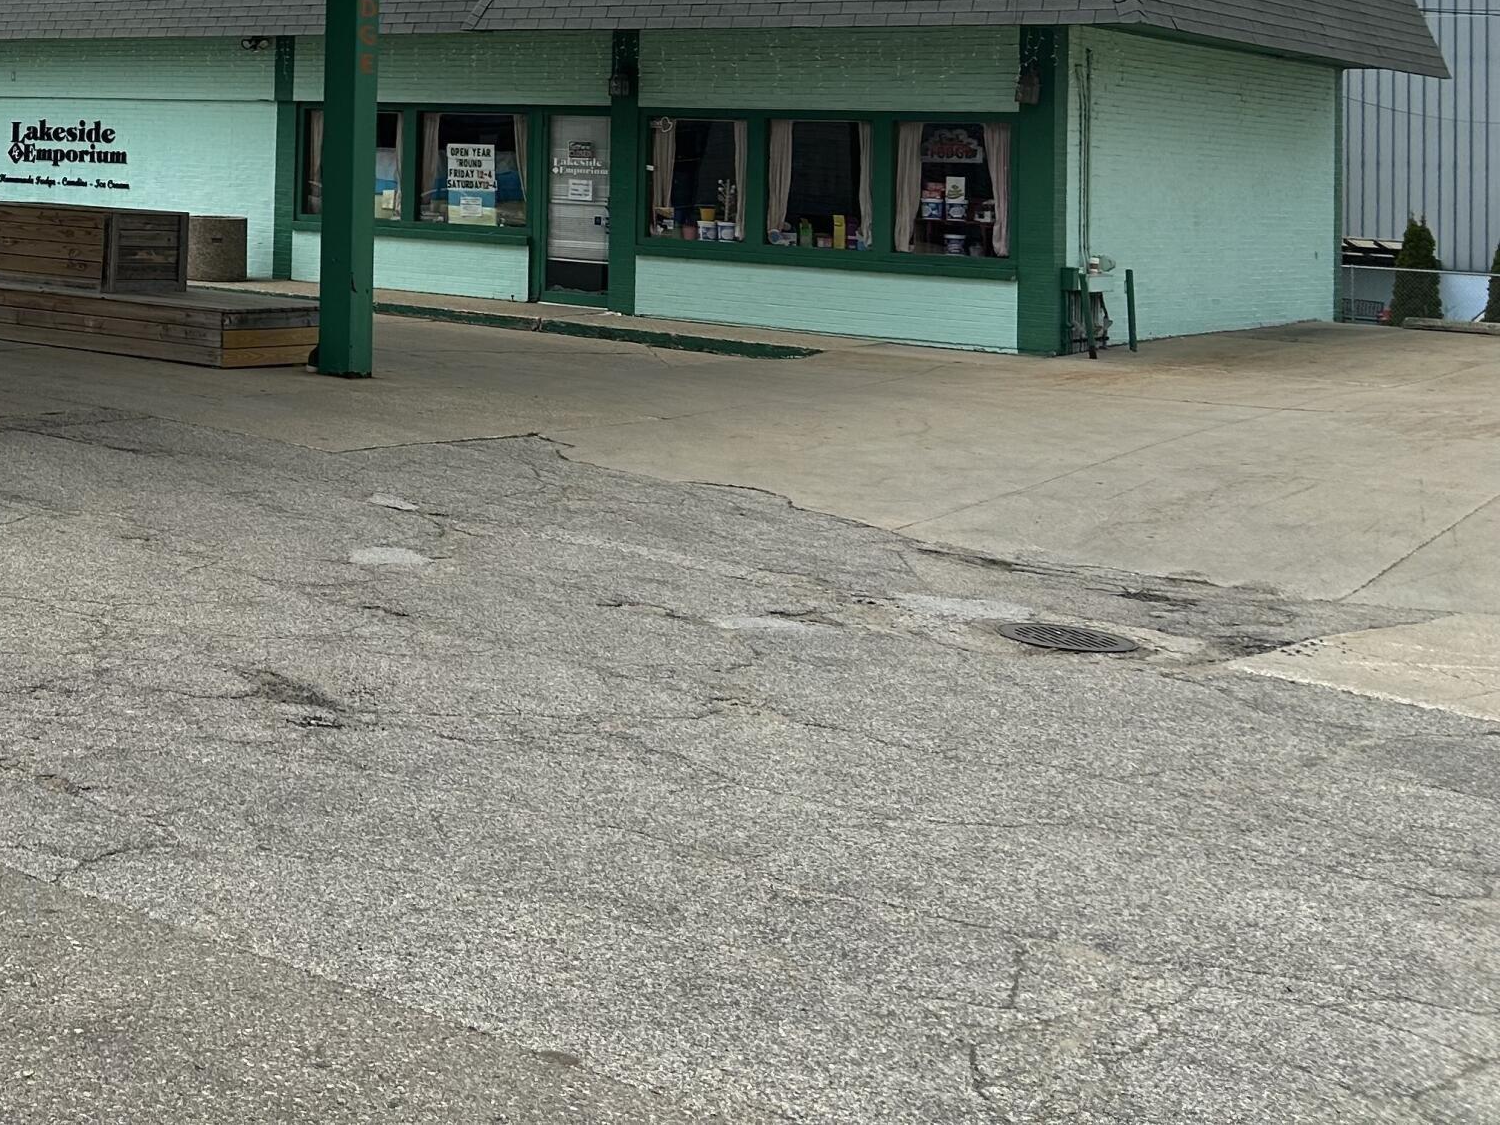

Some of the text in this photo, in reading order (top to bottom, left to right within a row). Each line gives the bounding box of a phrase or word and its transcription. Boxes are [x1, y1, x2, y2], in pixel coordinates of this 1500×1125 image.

[10, 118, 116, 145] Lakeside
[22, 143, 128, 167] Emporium
[450, 147, 491, 157] OPEN YEAR
[553, 157, 603, 167] Lakeside
[449, 169, 475, 179] FRIDAY
[560, 166, 609, 175] Emporium
[35, 176, 56, 188] Fudge
[94, 178, 107, 188] Ice
[447, 179, 482, 189] SATURDAY
